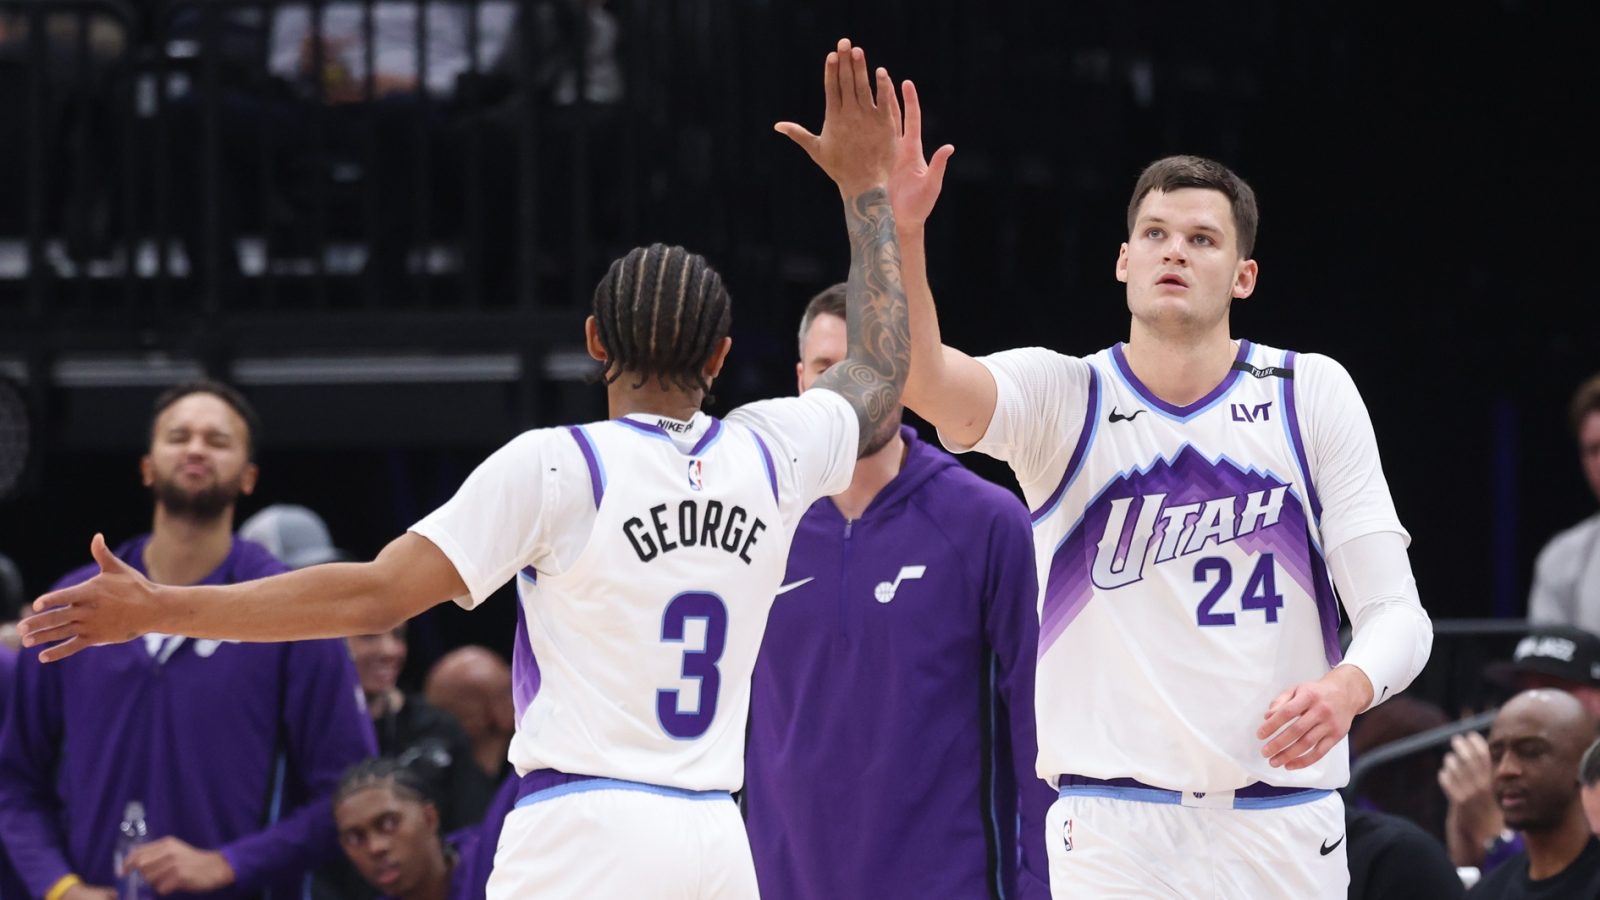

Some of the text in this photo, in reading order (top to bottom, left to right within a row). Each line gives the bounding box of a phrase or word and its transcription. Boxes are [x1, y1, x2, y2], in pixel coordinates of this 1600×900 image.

[1251, 367, 1274, 378] FRANK
[656, 418, 682, 433] NIKE
[1230, 401, 1273, 423] LVT
[622, 500, 767, 565] GEORGE
[1091, 482, 1293, 590] UTAH
[1192, 552, 1284, 627] 24
[655, 590, 729, 740] 3
